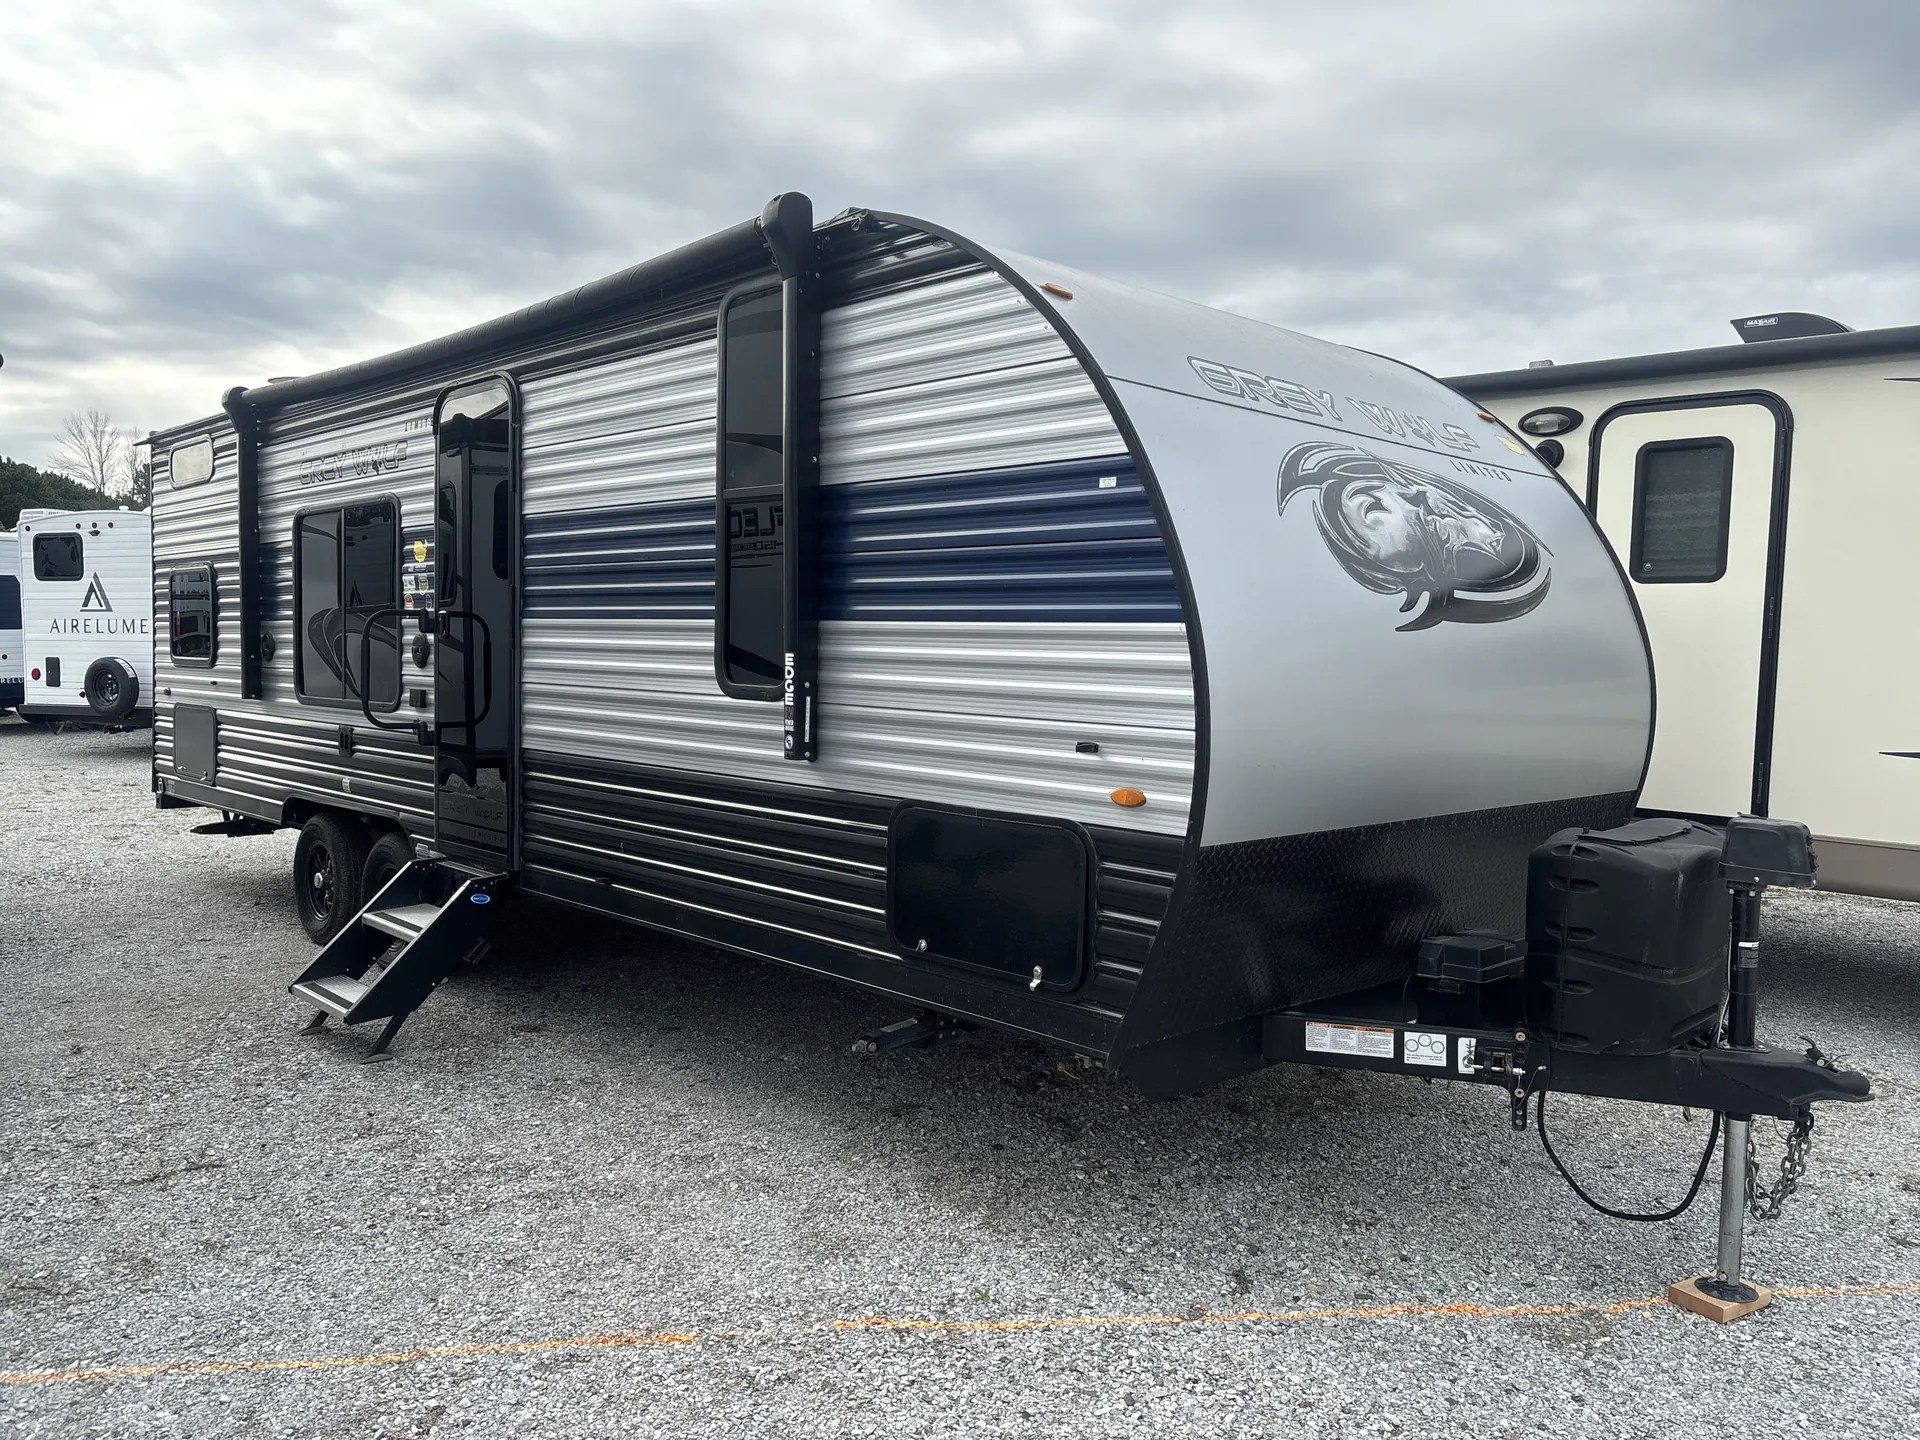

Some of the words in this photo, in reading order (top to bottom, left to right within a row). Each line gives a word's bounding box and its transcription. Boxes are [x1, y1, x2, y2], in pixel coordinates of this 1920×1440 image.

[1187, 356, 1343, 422] GREY
[299, 452, 346, 485] GREY
[1450, 459, 1512, 482] LIMITED
[50, 618, 149, 634] AIRELUME
[784, 652, 795, 706] EDGE
